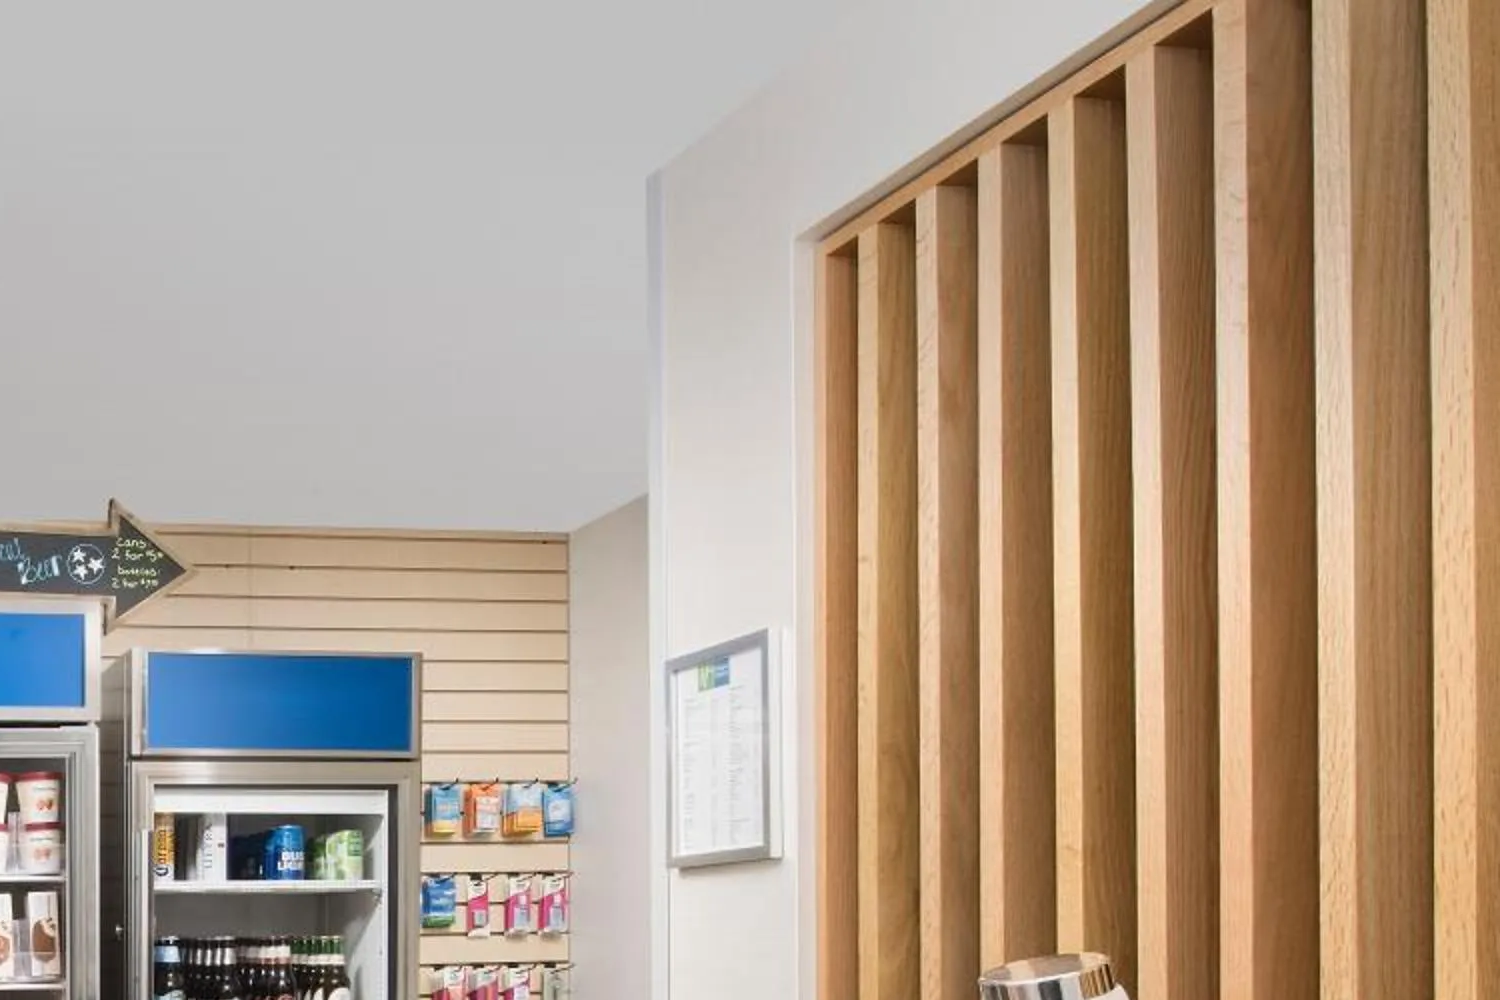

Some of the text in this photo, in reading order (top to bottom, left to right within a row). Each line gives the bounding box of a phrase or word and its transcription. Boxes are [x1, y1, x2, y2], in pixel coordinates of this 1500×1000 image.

[111, 548, 121, 559] 2
[125, 549, 144, 561] for
[111, 577, 121, 589] 2
